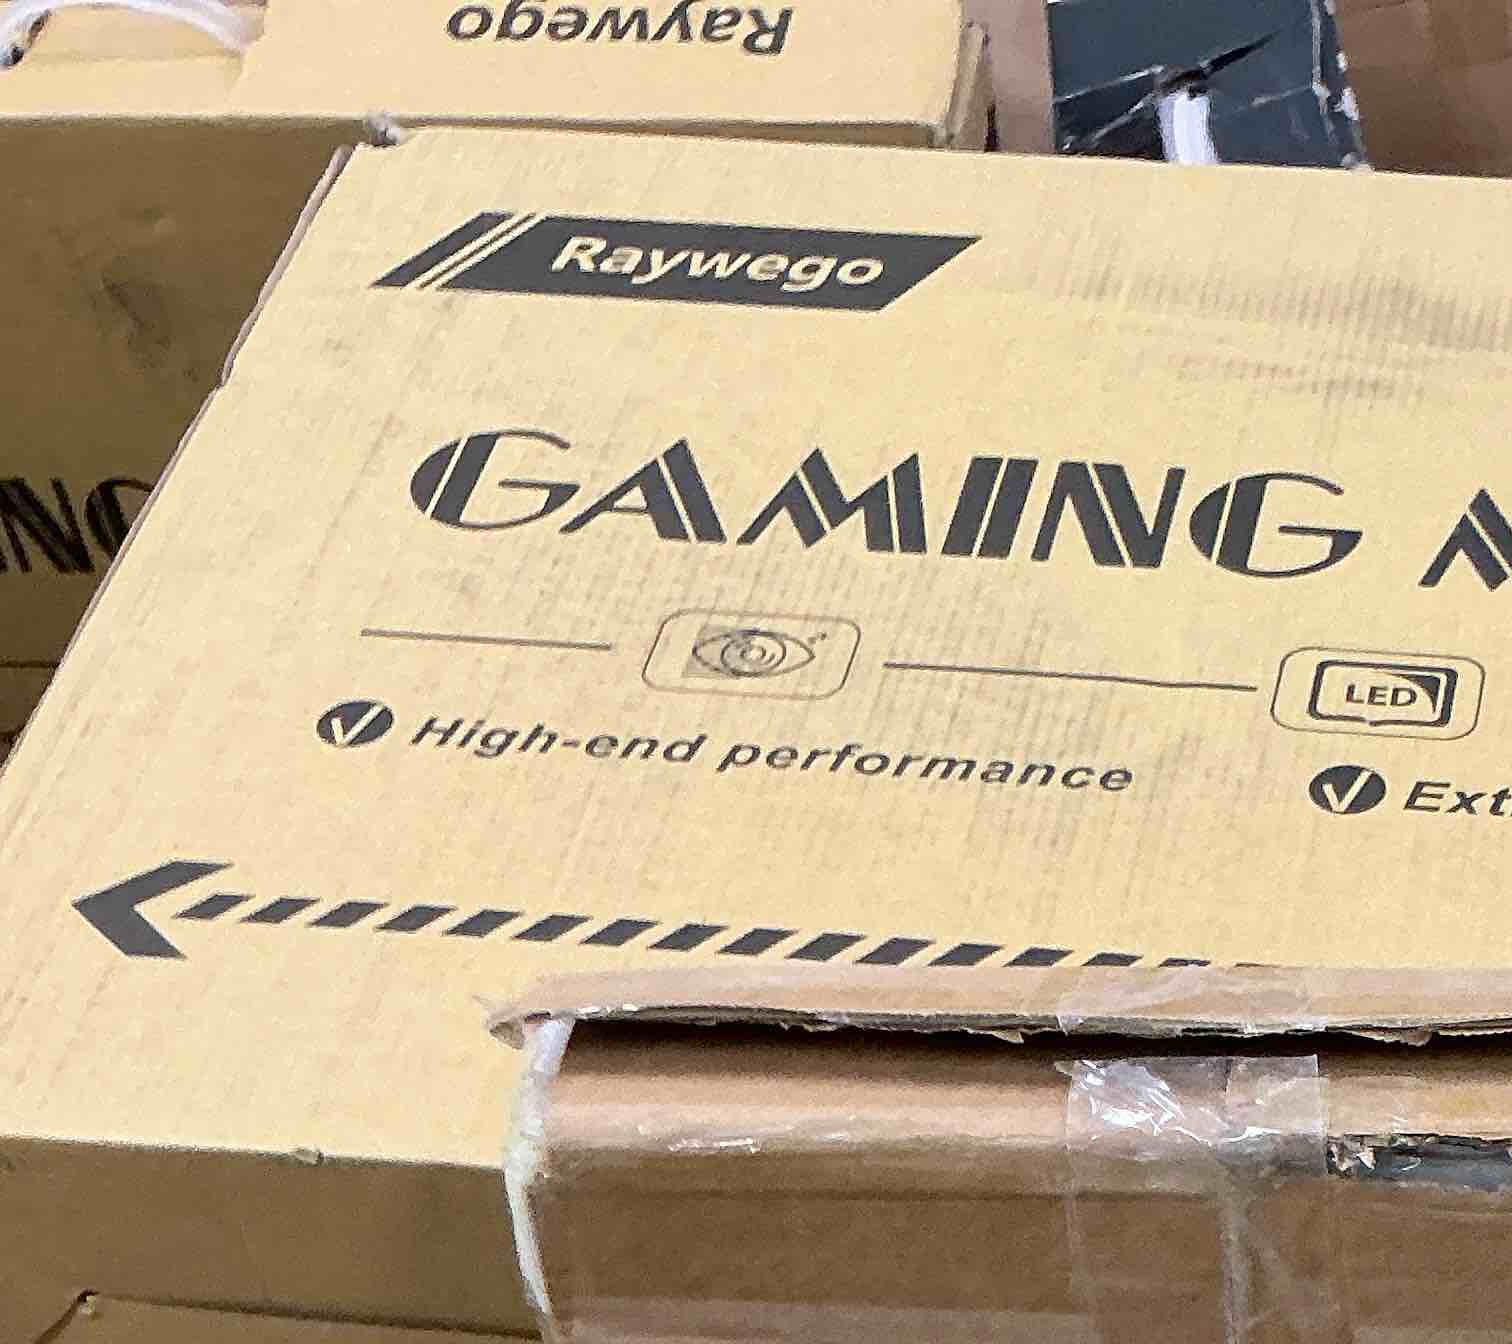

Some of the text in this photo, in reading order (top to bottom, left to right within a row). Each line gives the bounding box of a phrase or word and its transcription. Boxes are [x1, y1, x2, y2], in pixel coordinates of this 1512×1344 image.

[446, 0, 793, 55] Raywego
[550, 235, 886, 292] Raywego
[410, 428, 1363, 579] GAMING
[1345, 681, 1418, 709] LED
[410, 714, 1135, 794] High-end performance
